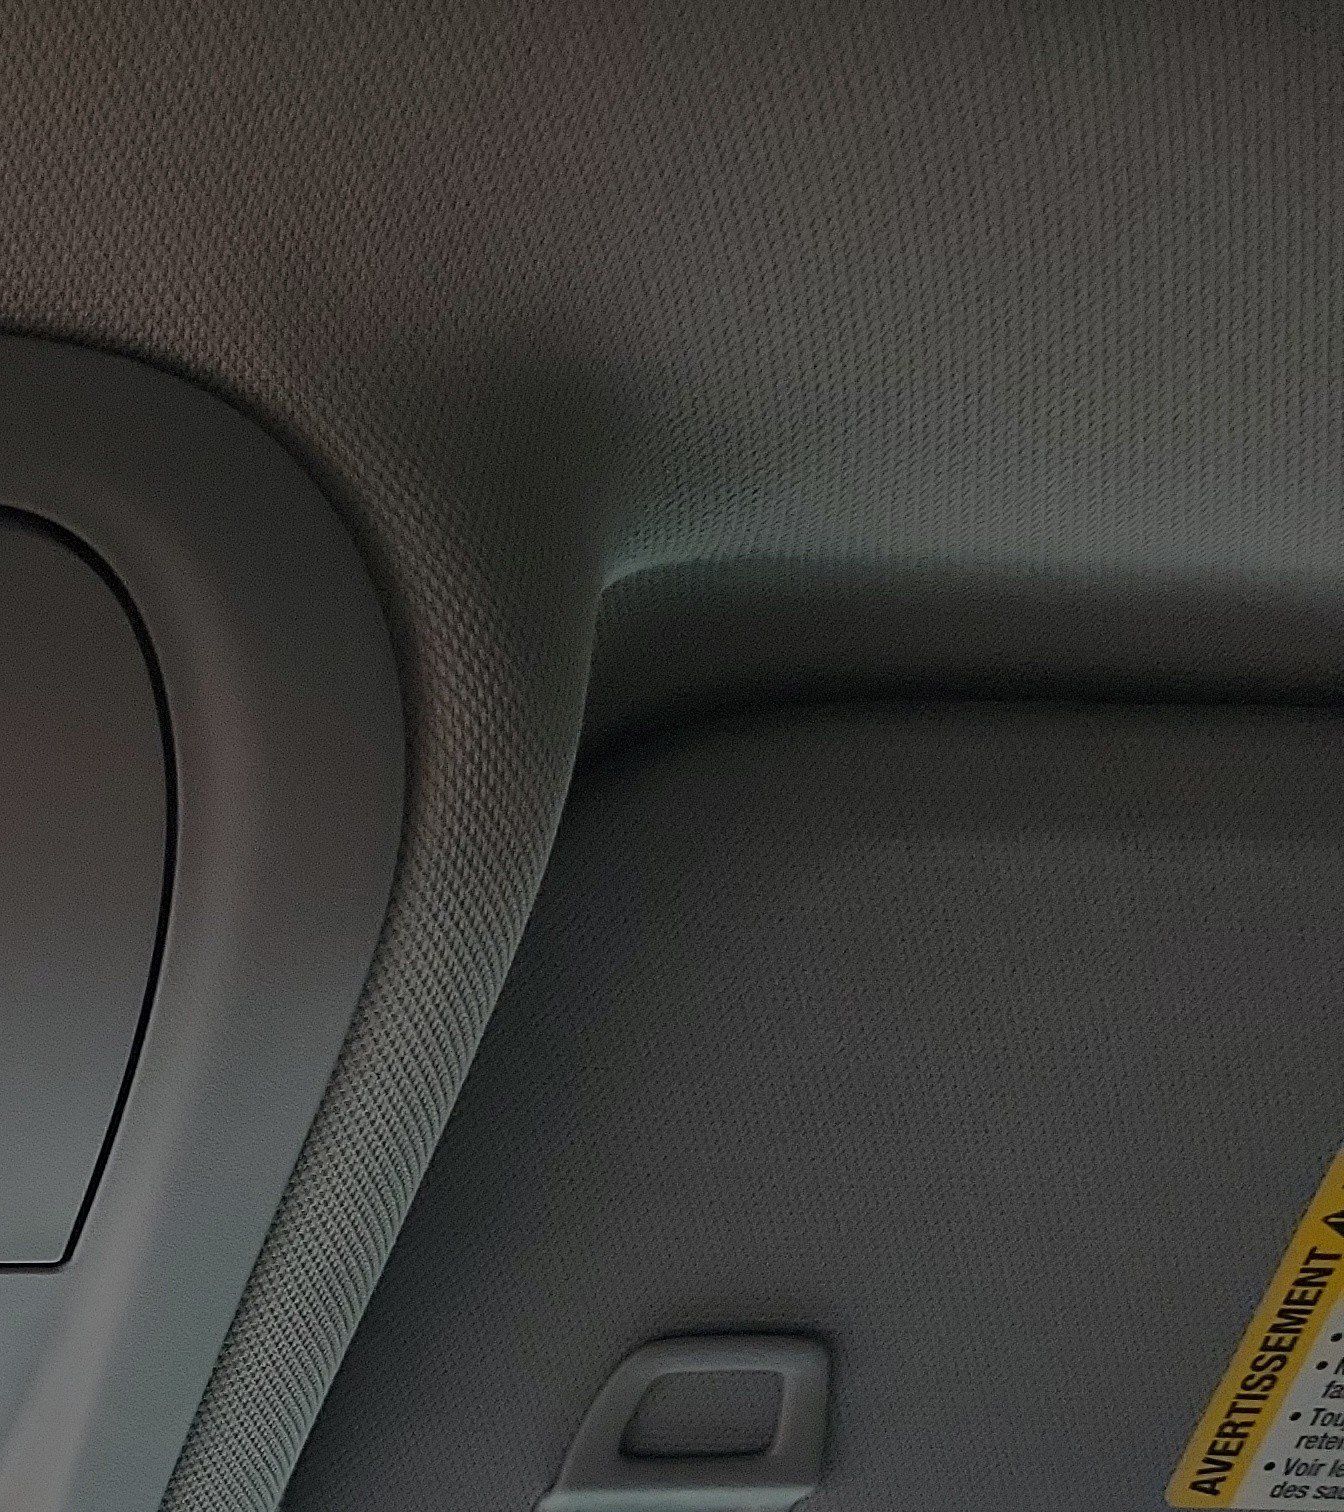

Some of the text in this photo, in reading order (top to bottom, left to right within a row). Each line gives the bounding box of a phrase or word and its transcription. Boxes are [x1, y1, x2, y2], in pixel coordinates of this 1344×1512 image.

[1189, 1246, 1343, 1496] AVERTISSEMENT
[1283, 1458, 1326, 1477] Voir
[1269, 1481, 1310, 1499] des
